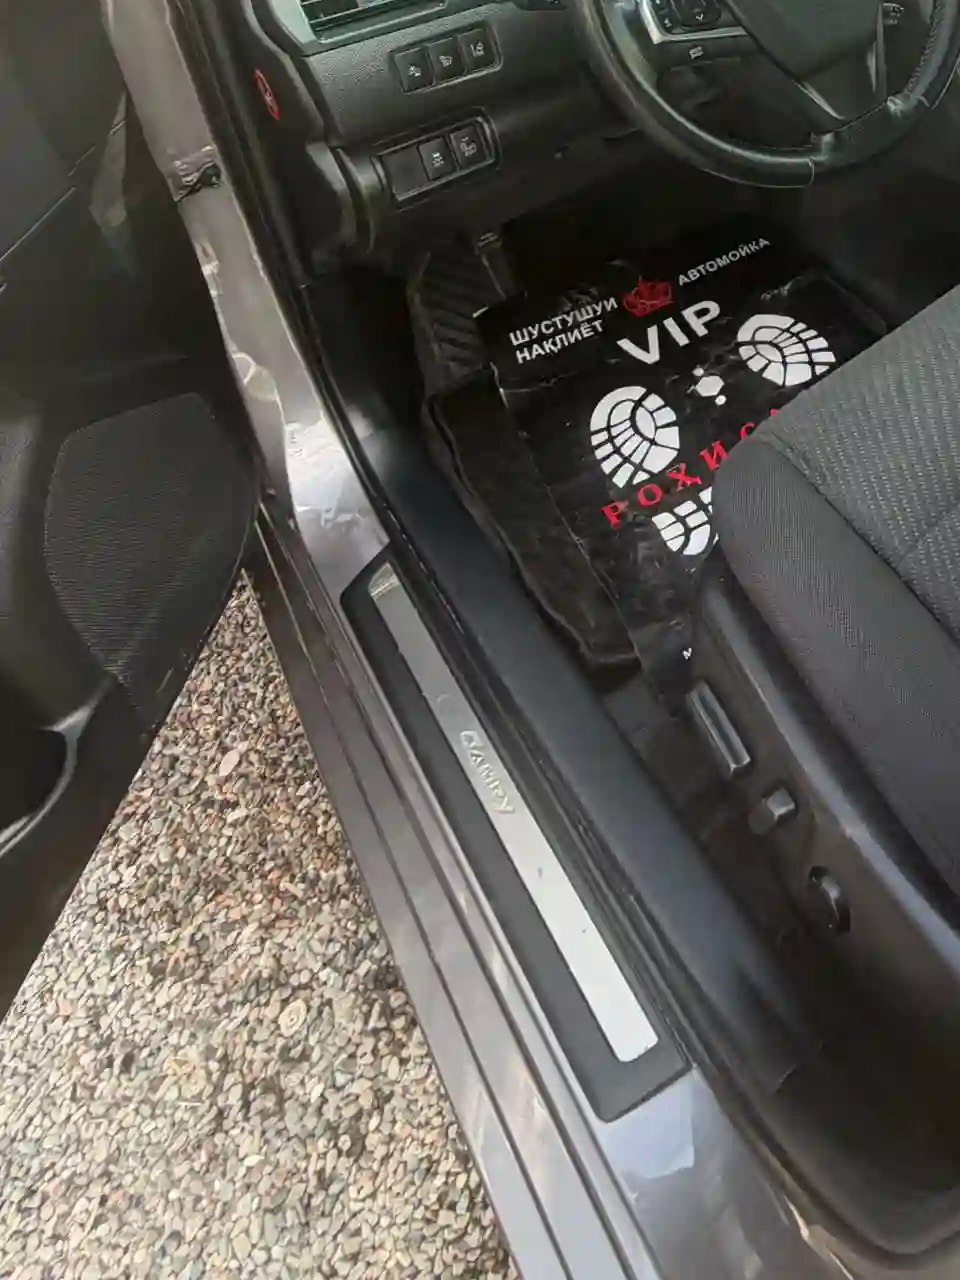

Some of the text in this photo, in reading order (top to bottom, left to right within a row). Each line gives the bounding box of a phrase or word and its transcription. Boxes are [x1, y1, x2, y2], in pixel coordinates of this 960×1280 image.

[678, 238, 770, 285] АВТОМОЙКА
[616, 300, 720, 364] VIP
[461, 730, 515, 813] CAMRY
